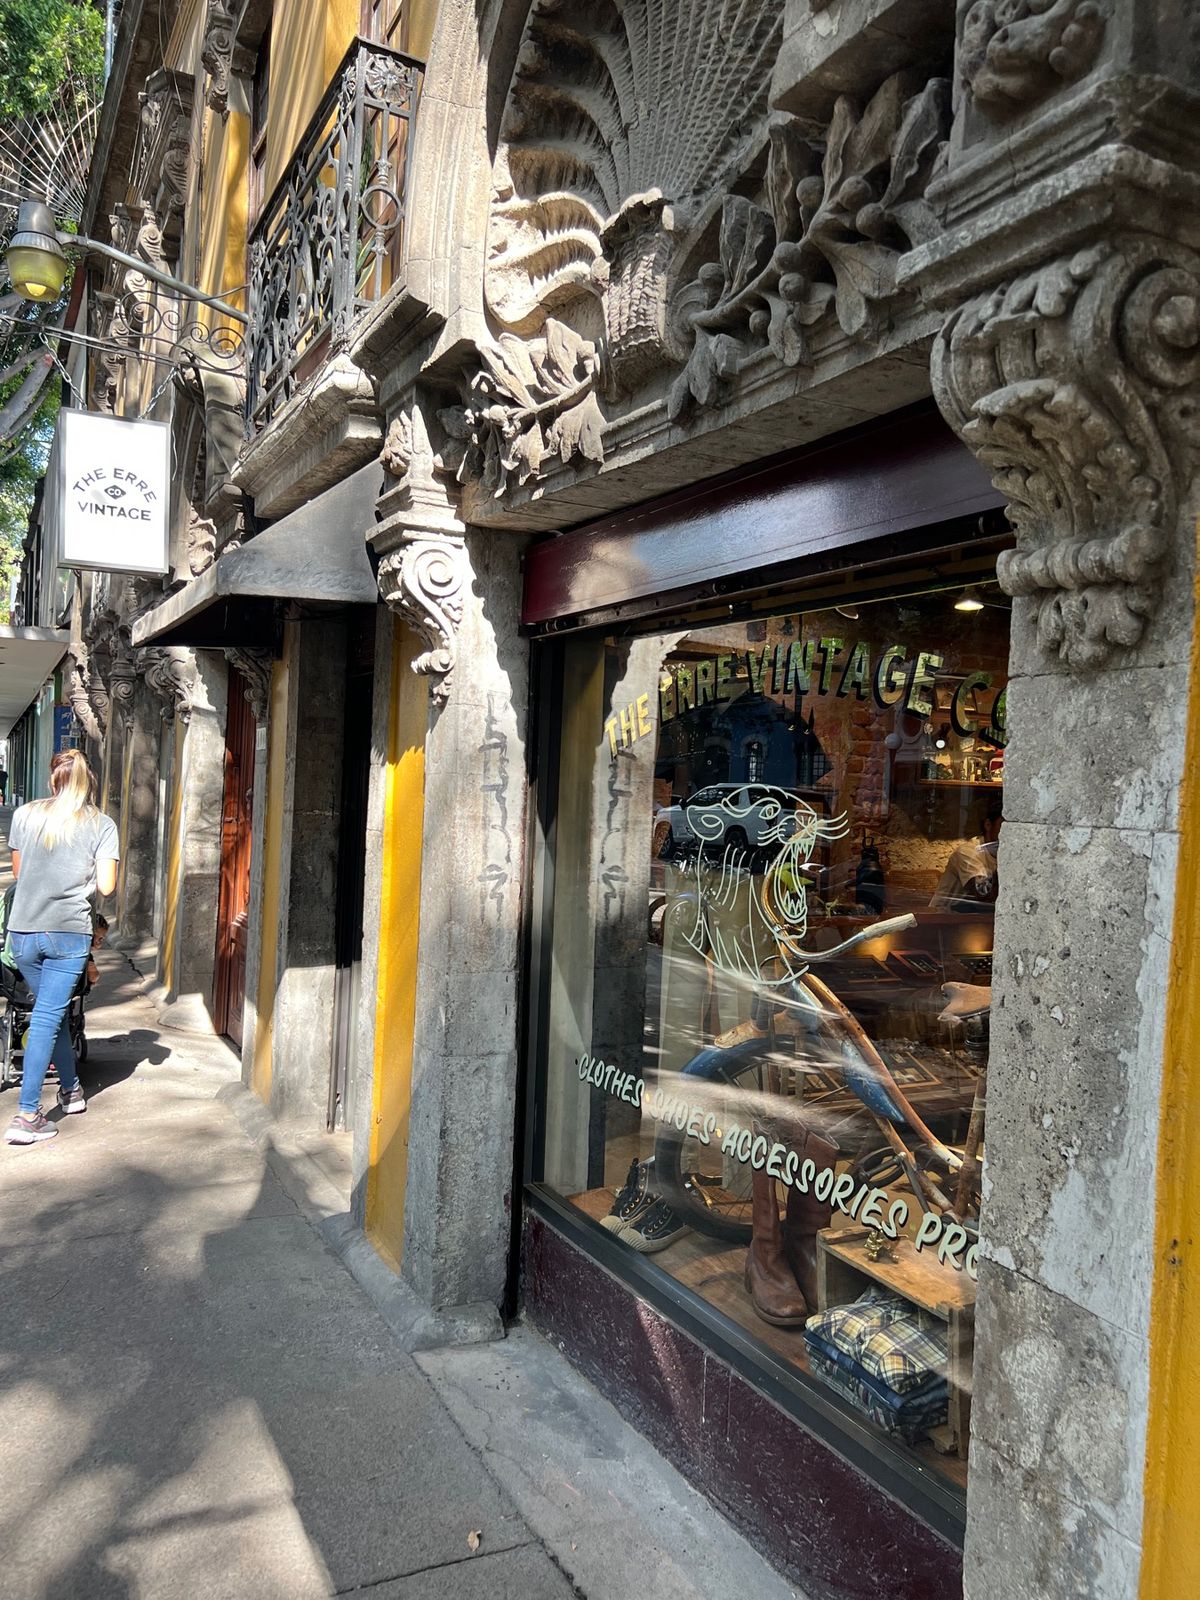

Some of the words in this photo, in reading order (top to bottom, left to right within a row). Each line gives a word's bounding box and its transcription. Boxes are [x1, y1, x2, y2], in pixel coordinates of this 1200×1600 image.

[73, 468, 106, 493] THE
[113, 467, 157, 503] ERRE
[78, 501, 152, 521] VINTAGE
[604, 692, 653, 757] THE
[658, 654, 732, 727] ERRE
[745, 637, 944, 719] VINTAGE
[578, 1052, 645, 1108] CLOTHES
[650, 1088, 717, 1145] SHOES
[721, 1123, 909, 1238] ACCESSORIES
